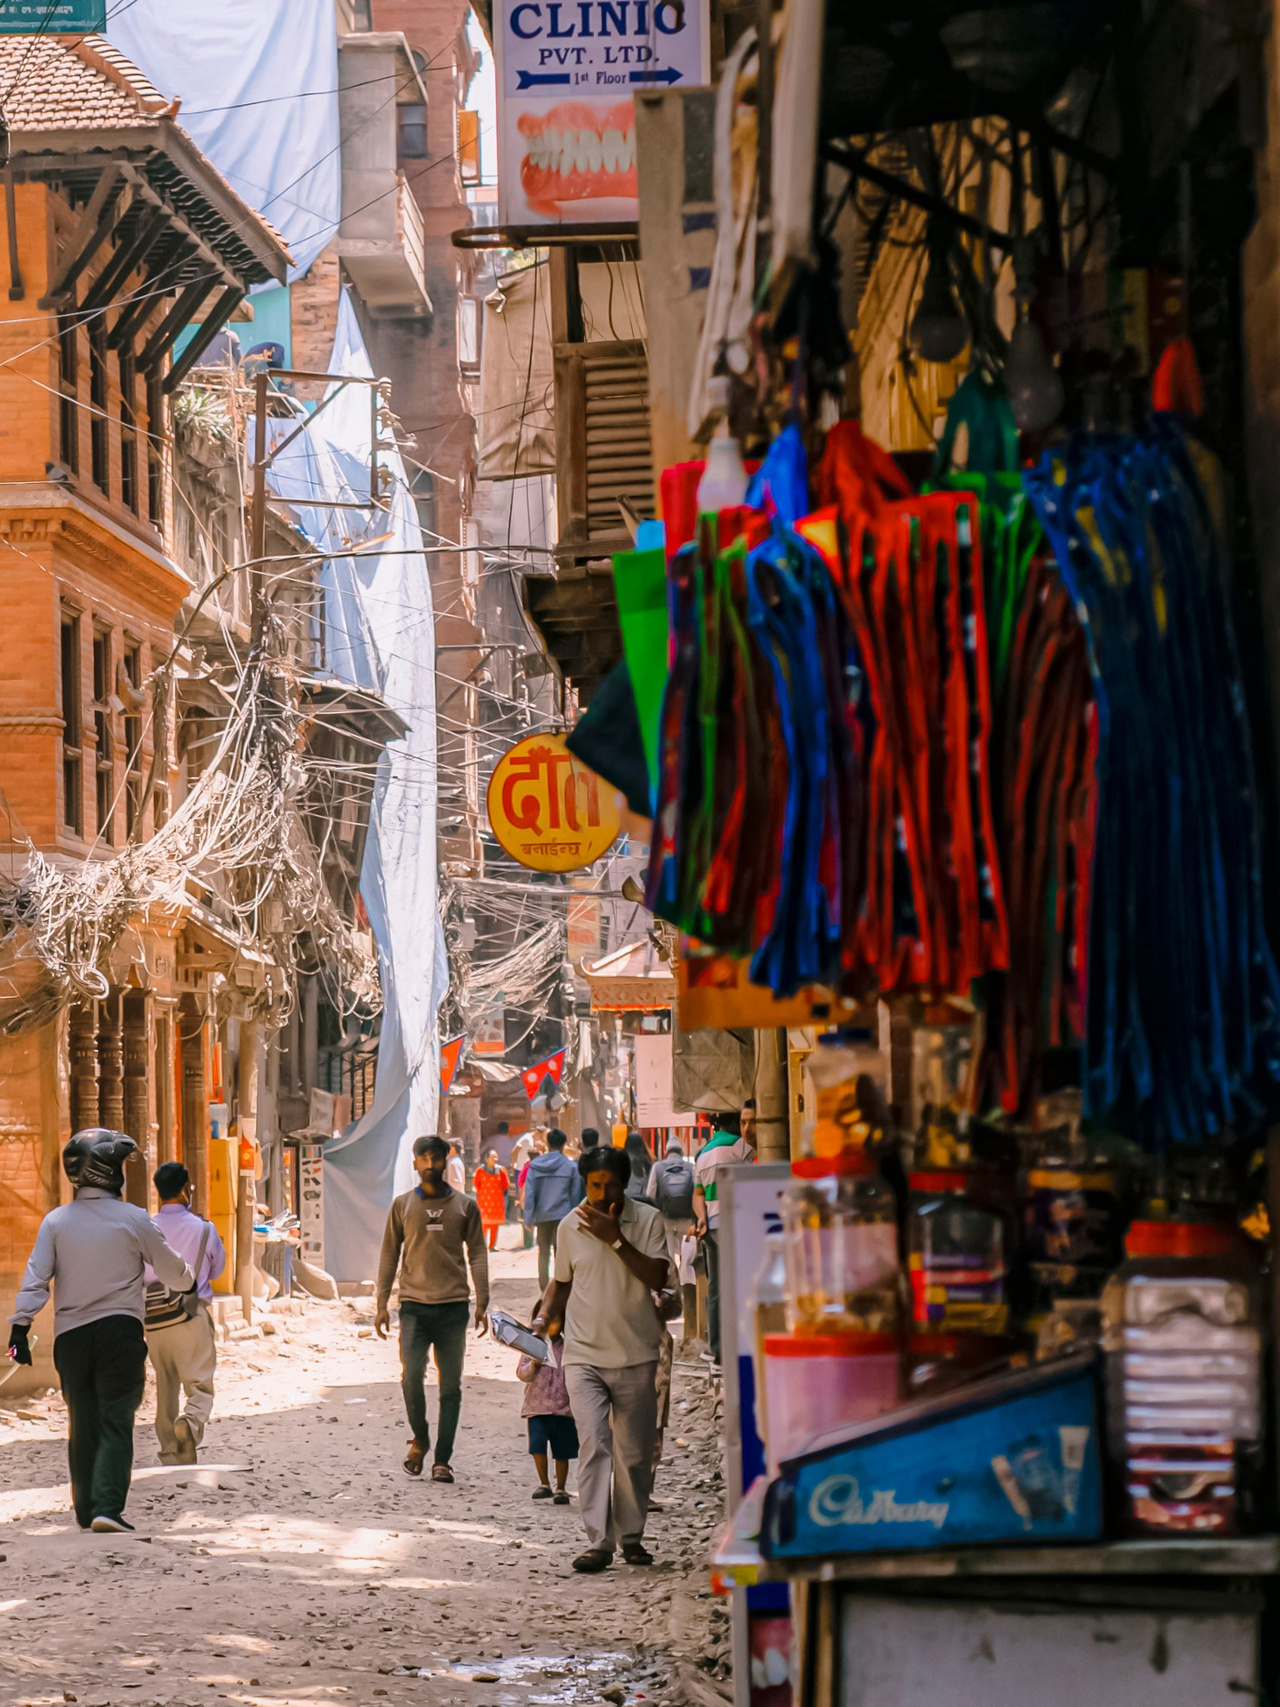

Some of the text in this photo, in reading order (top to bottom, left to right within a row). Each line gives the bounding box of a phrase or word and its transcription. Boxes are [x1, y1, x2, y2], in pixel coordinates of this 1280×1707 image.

[509, 0, 687, 39] CLINIC
[538, 46, 660, 66] PVT. LTD.
[575, 71, 626, 85] 1st Floor
